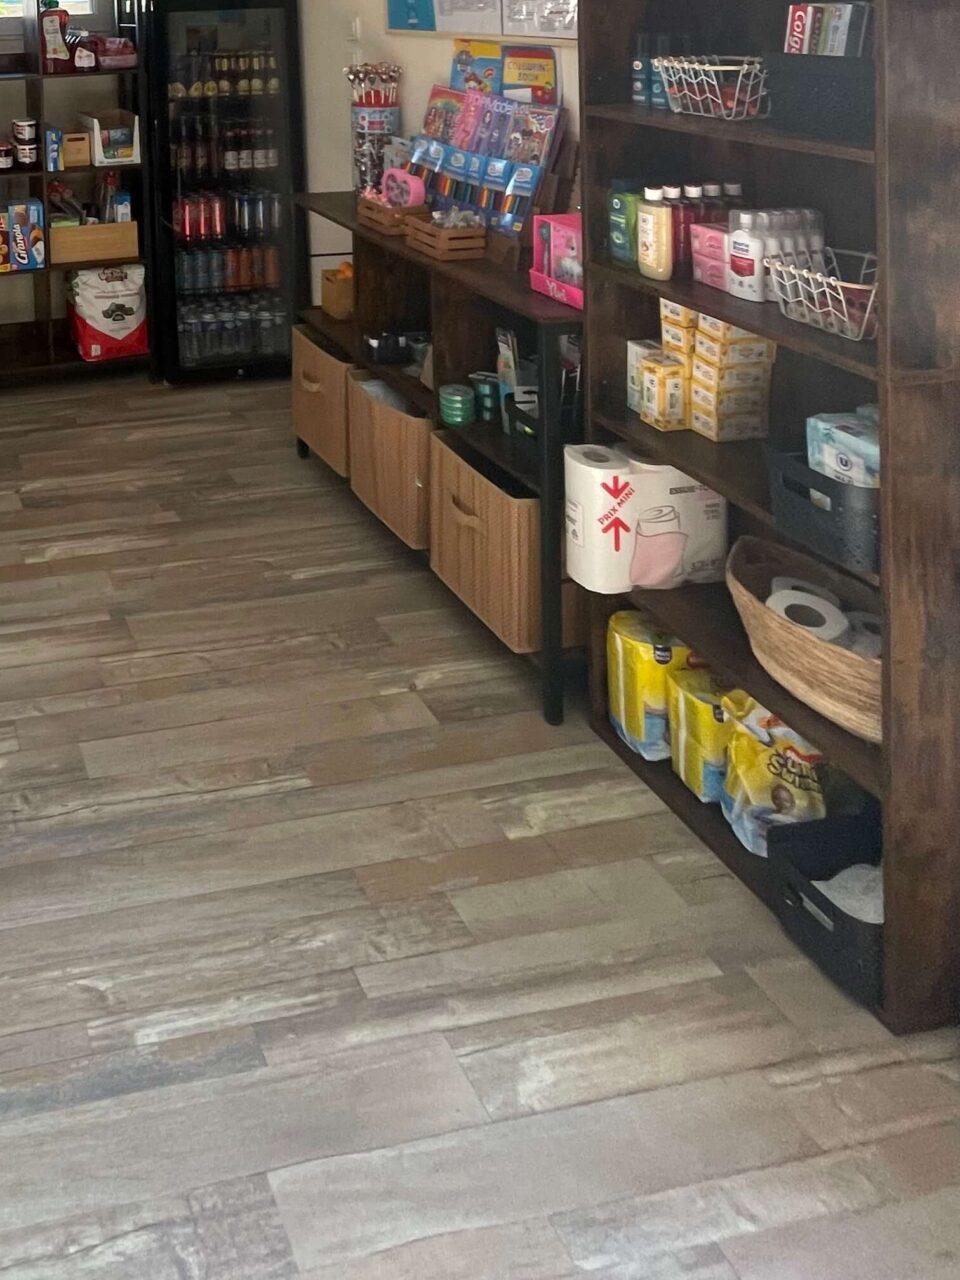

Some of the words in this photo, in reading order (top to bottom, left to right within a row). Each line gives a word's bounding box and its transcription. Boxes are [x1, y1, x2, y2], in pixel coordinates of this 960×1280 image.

[12, 223, 29, 265] Granola
[597, 505, 619, 526] PRIX
[616, 486, 636, 509] MINI
